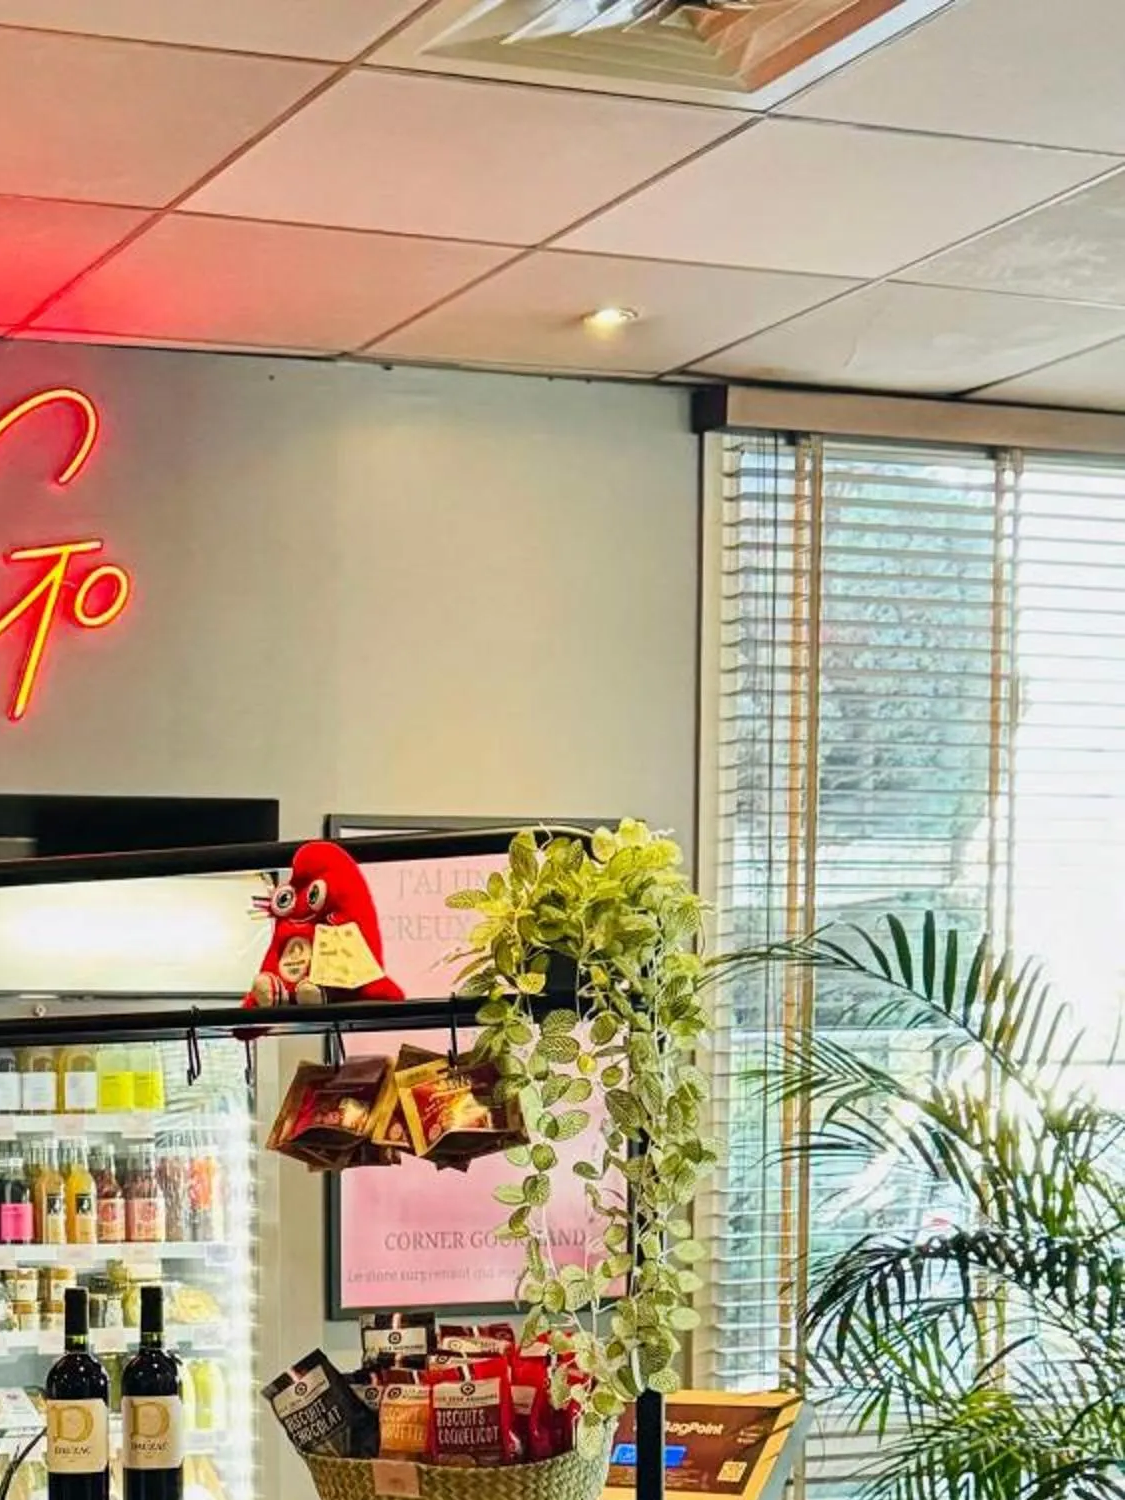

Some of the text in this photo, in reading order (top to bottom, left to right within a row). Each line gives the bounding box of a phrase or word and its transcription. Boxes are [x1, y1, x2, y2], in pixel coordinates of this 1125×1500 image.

[384, 1231, 465, 1251] CORNER
[49, 1405, 94, 1443] D
[131, 1402, 171, 1439] D
[435, 1408, 486, 1427] BISCUITS
